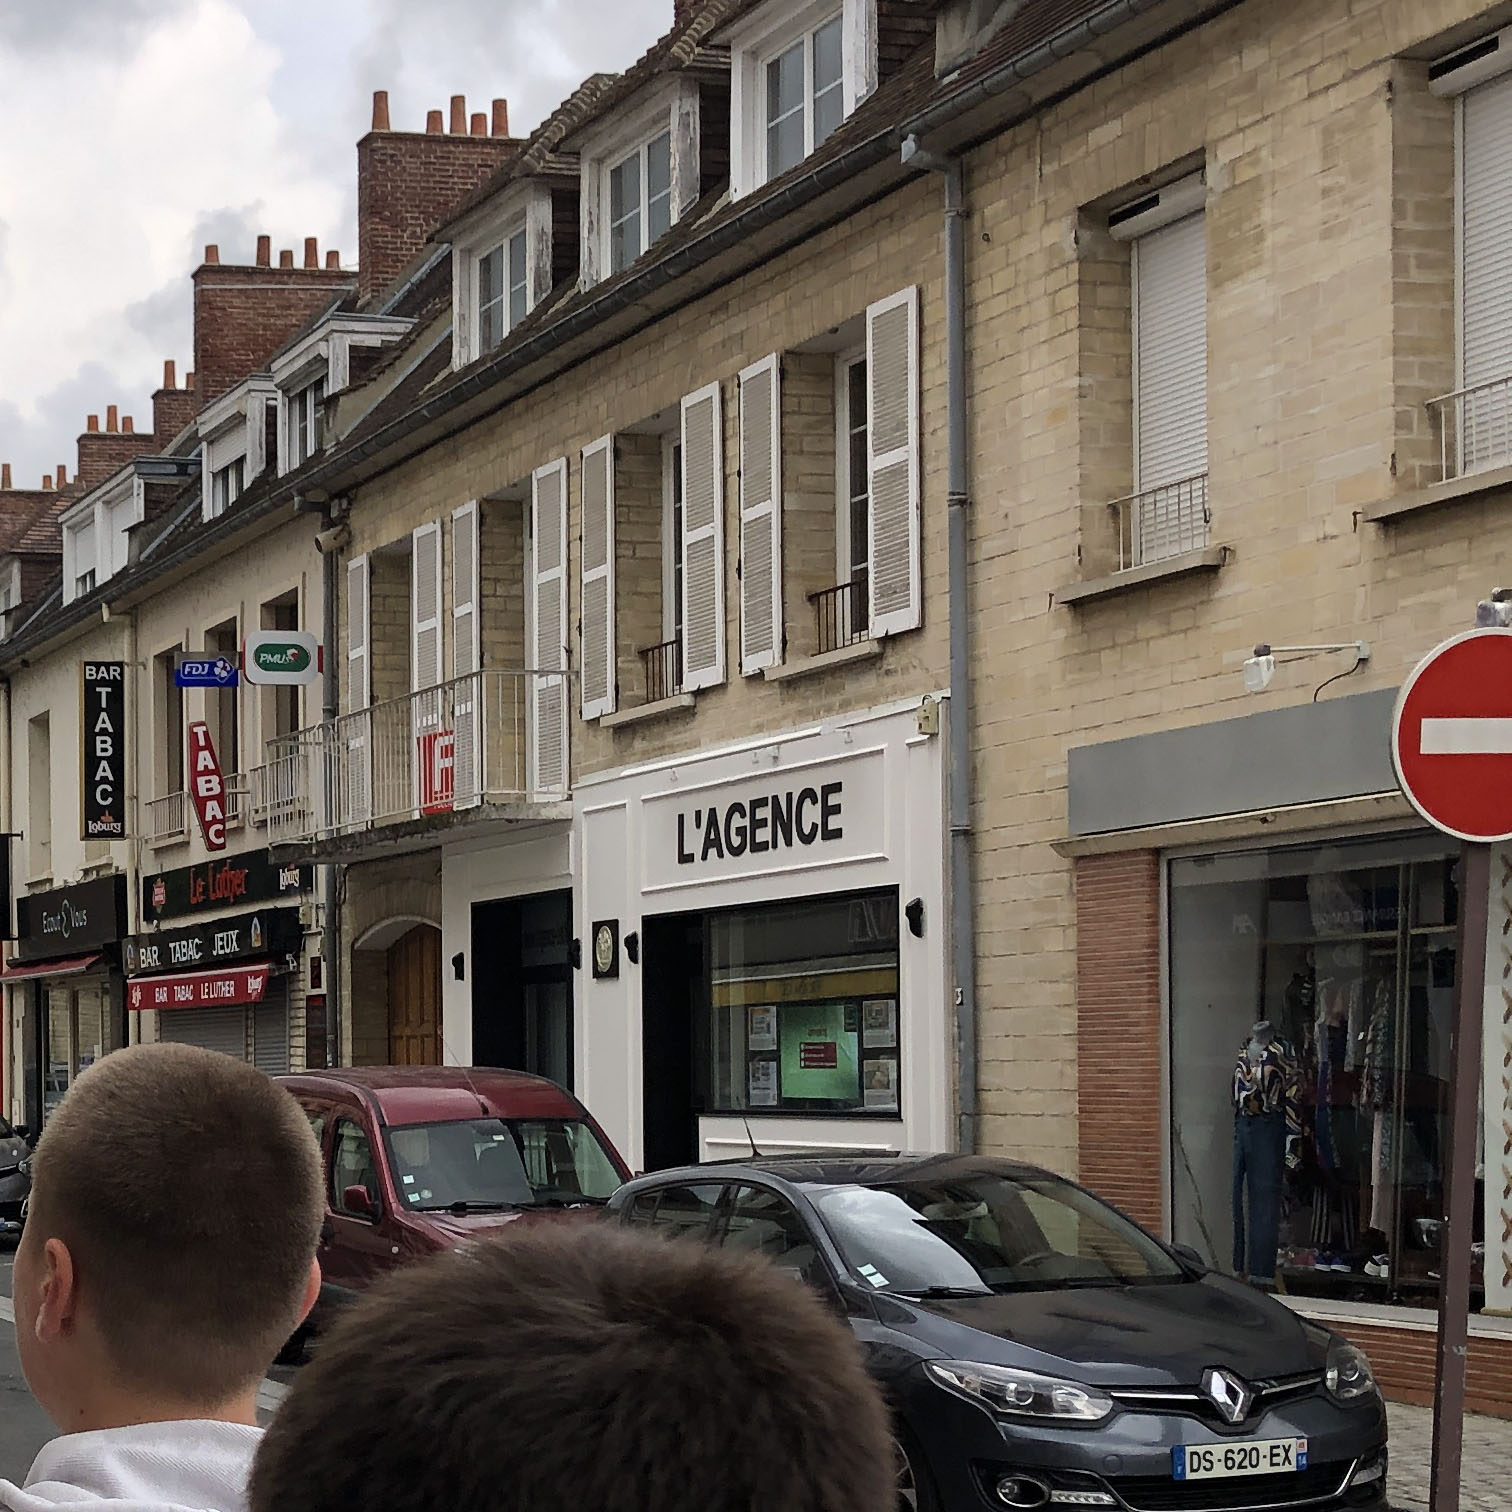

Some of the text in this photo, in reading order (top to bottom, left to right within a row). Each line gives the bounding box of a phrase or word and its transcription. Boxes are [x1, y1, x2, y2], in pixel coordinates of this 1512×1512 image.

[85, 665, 121, 681] BAR
[184, 663, 209, 675] FDJ
[259, 654, 285, 665] PMU
[94, 686, 114, 806] TABAC
[192, 725, 225, 846] TABAC
[677, 781, 843, 864] L'AGENCE
[190, 867, 205, 904] Le
[140, 929, 240, 969] BAR TABAC JEUX
[155, 986, 168, 1003] BAR
[174, 984, 194, 1001] TABAC
[209, 980, 235, 998] LUTHER
[1189, 1443, 1292, 1473] DS-620-EX
